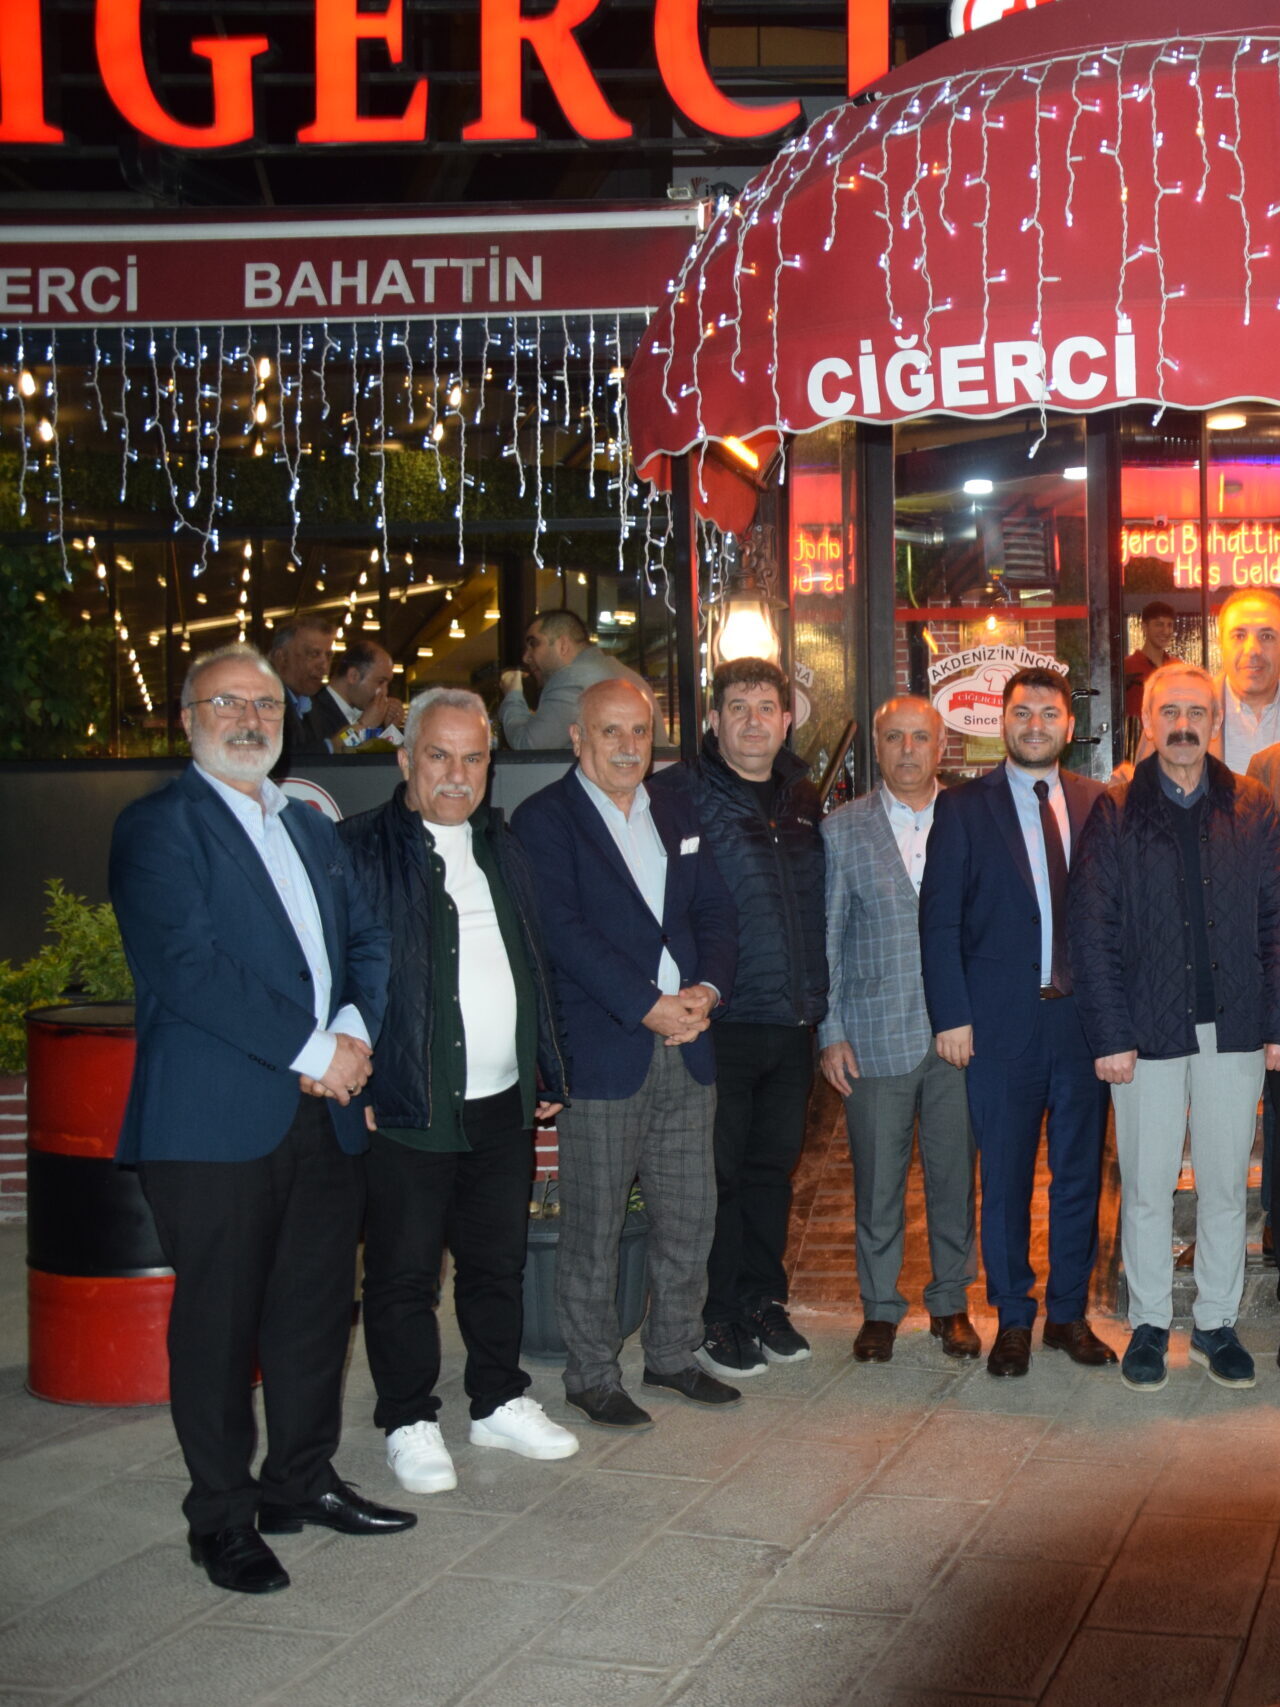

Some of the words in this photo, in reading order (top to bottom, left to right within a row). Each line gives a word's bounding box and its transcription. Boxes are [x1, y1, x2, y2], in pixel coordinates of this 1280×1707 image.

[244, 246, 542, 308] BAHATTİN
[807, 318, 1137, 418] CİĞERCİ
[964, 715, 998, 726] Since
